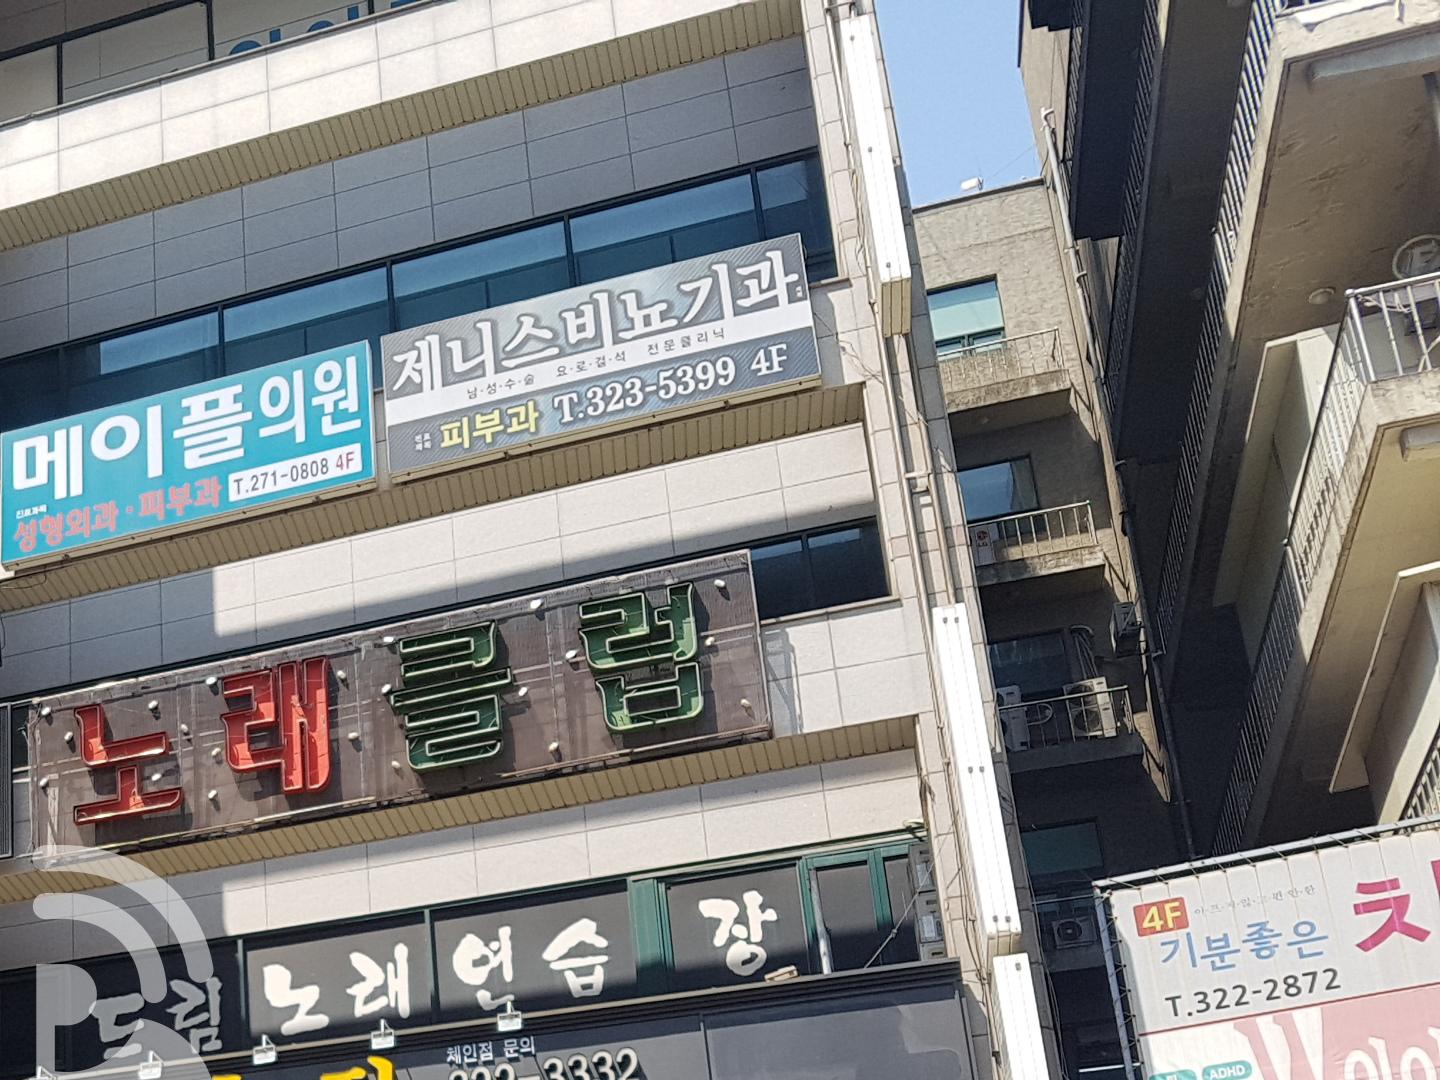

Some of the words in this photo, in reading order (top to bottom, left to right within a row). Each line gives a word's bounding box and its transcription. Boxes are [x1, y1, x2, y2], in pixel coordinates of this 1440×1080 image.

[392, 250, 800, 394] 제니스비뇨기과
[12, 355, 362, 500] 메이플의원
[440, 400, 540, 449] 피부과
[553, 355, 737, 423] T.323-5399
[750, 343, 789, 376] 4F
[233, 455, 330, 497] T.271-0808
[335, 451, 357, 472] 4F
[14, 500, 120, 552] 성형외과
[138, 476, 224, 522] 피부과
[1142, 900, 1183, 931] 4F
[1160, 919, 1329, 972] 기분좋은
[262, 890, 778, 1035] 노래연습장
[1165, 967, 1342, 1018] T.322-2872
[446, 1043, 494, 1065] 체인점
[504, 1035, 536, 1058] 문의
